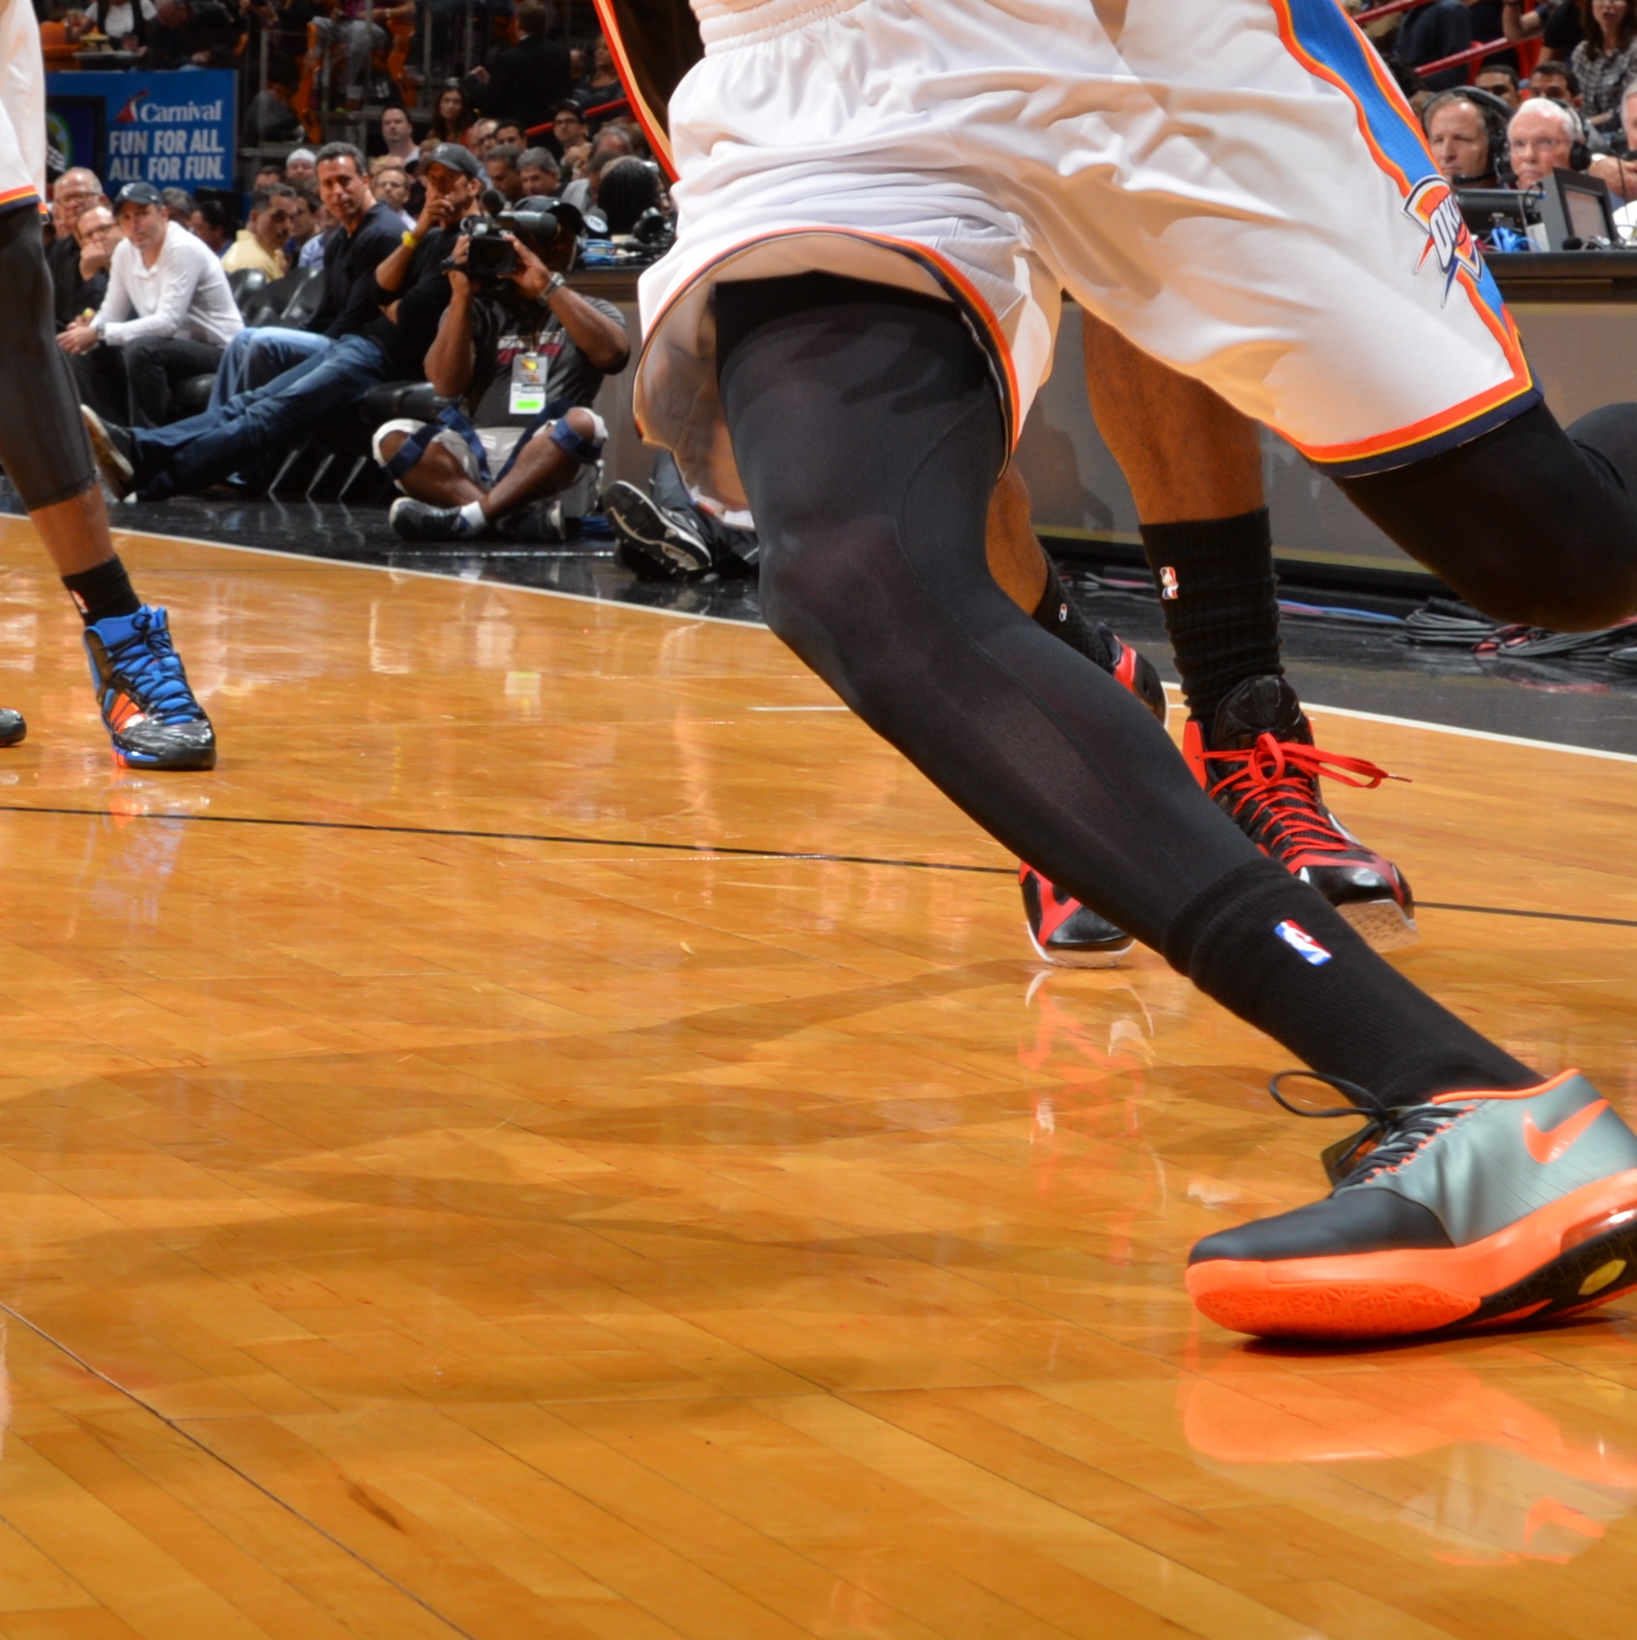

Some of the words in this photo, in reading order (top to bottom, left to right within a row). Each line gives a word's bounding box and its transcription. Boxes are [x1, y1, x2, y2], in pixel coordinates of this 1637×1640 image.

[140, 99, 223, 123] Carnival
[108, 130, 149, 155] FUN
[153, 129, 188, 155] FOR
[108, 157, 143, 181] ALL
[147, 156, 182, 182] FOR
